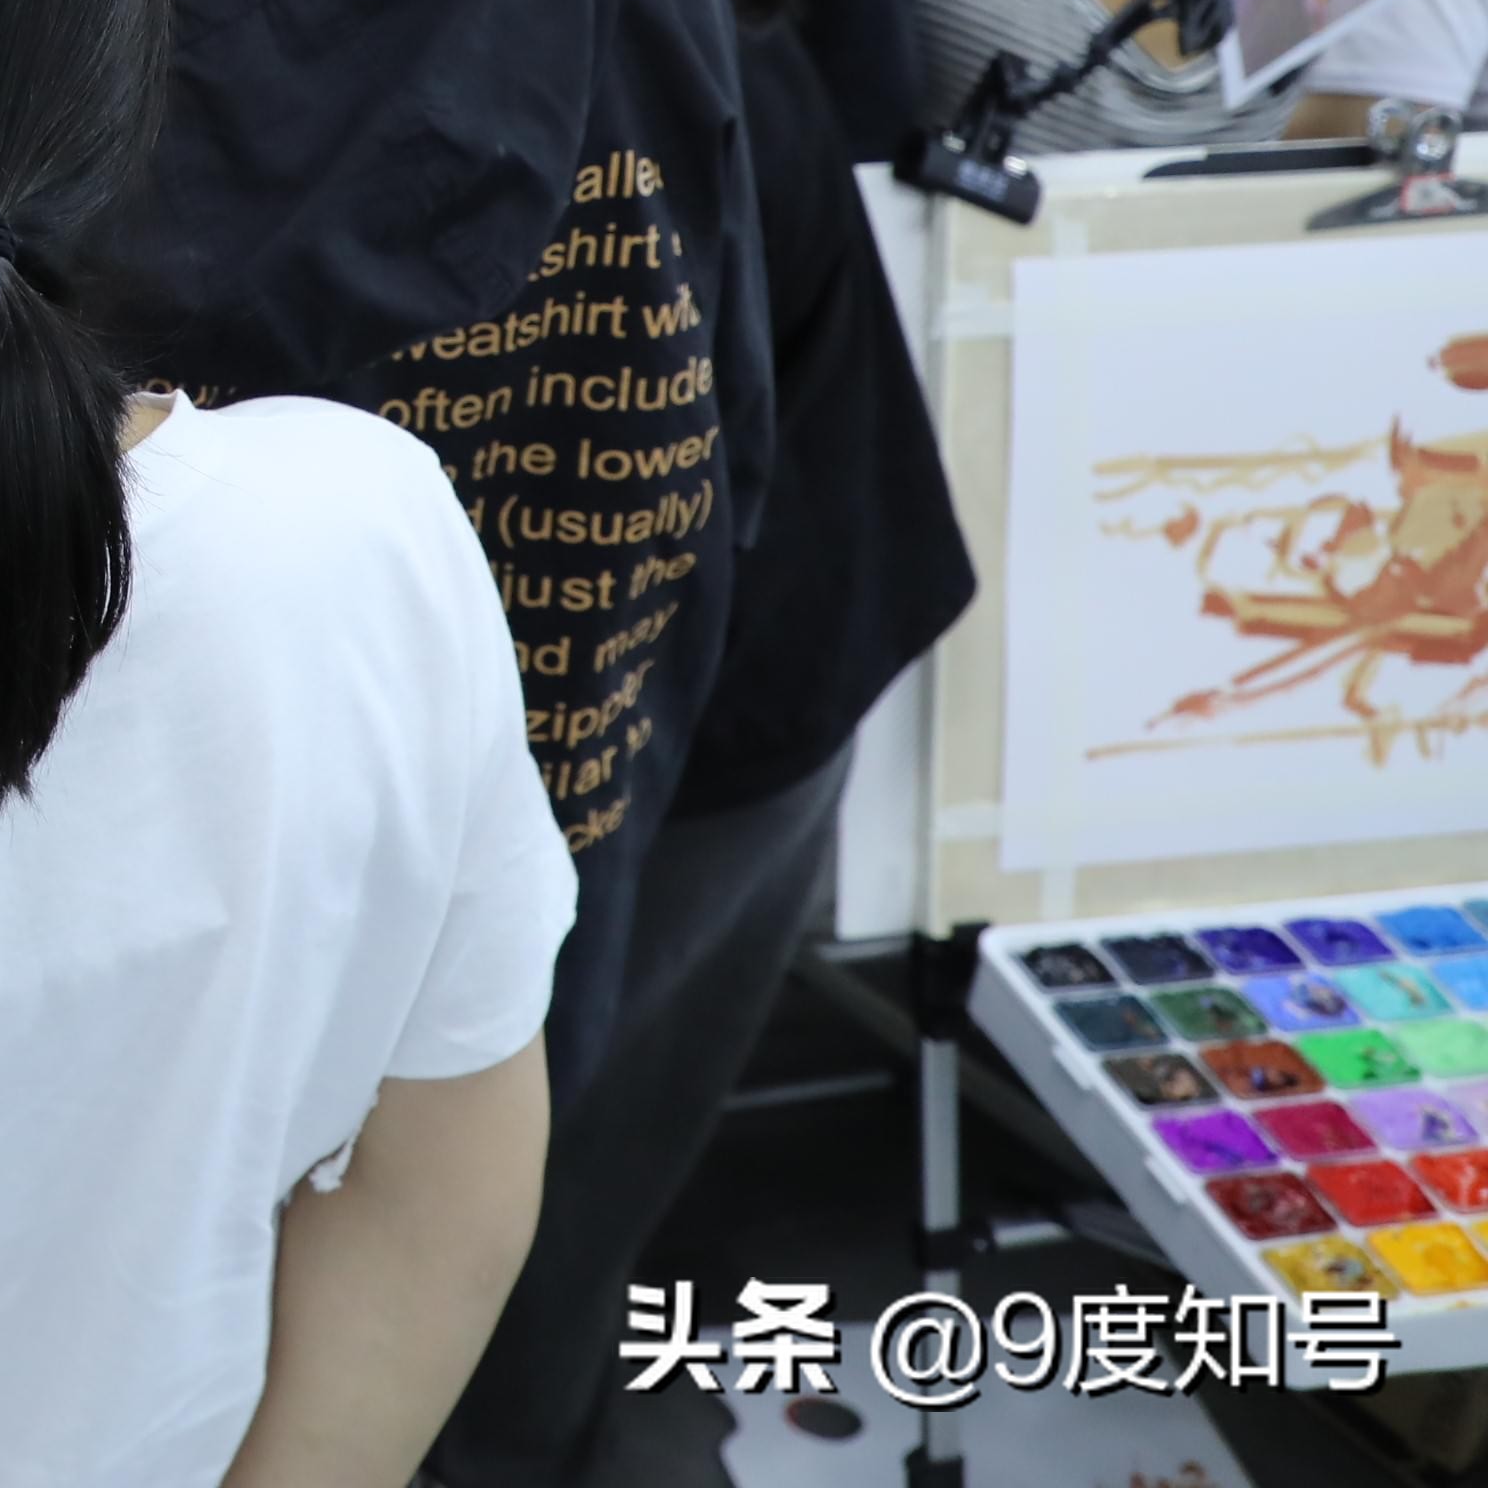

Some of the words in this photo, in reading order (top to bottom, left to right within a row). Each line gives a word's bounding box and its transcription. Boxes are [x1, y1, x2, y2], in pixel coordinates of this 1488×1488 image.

[528, 222, 662, 282] shirt
[378, 386, 513, 431] often
[525, 356, 714, 412] include
[472, 440, 557, 481] the
[578, 425, 720, 481] lower
[498, 478, 714, 549] (usually)
[490, 560, 617, 613] just
[628, 552, 697, 601] the
[593, 601, 679, 673] may
[525, 659, 654, 750] zipper
